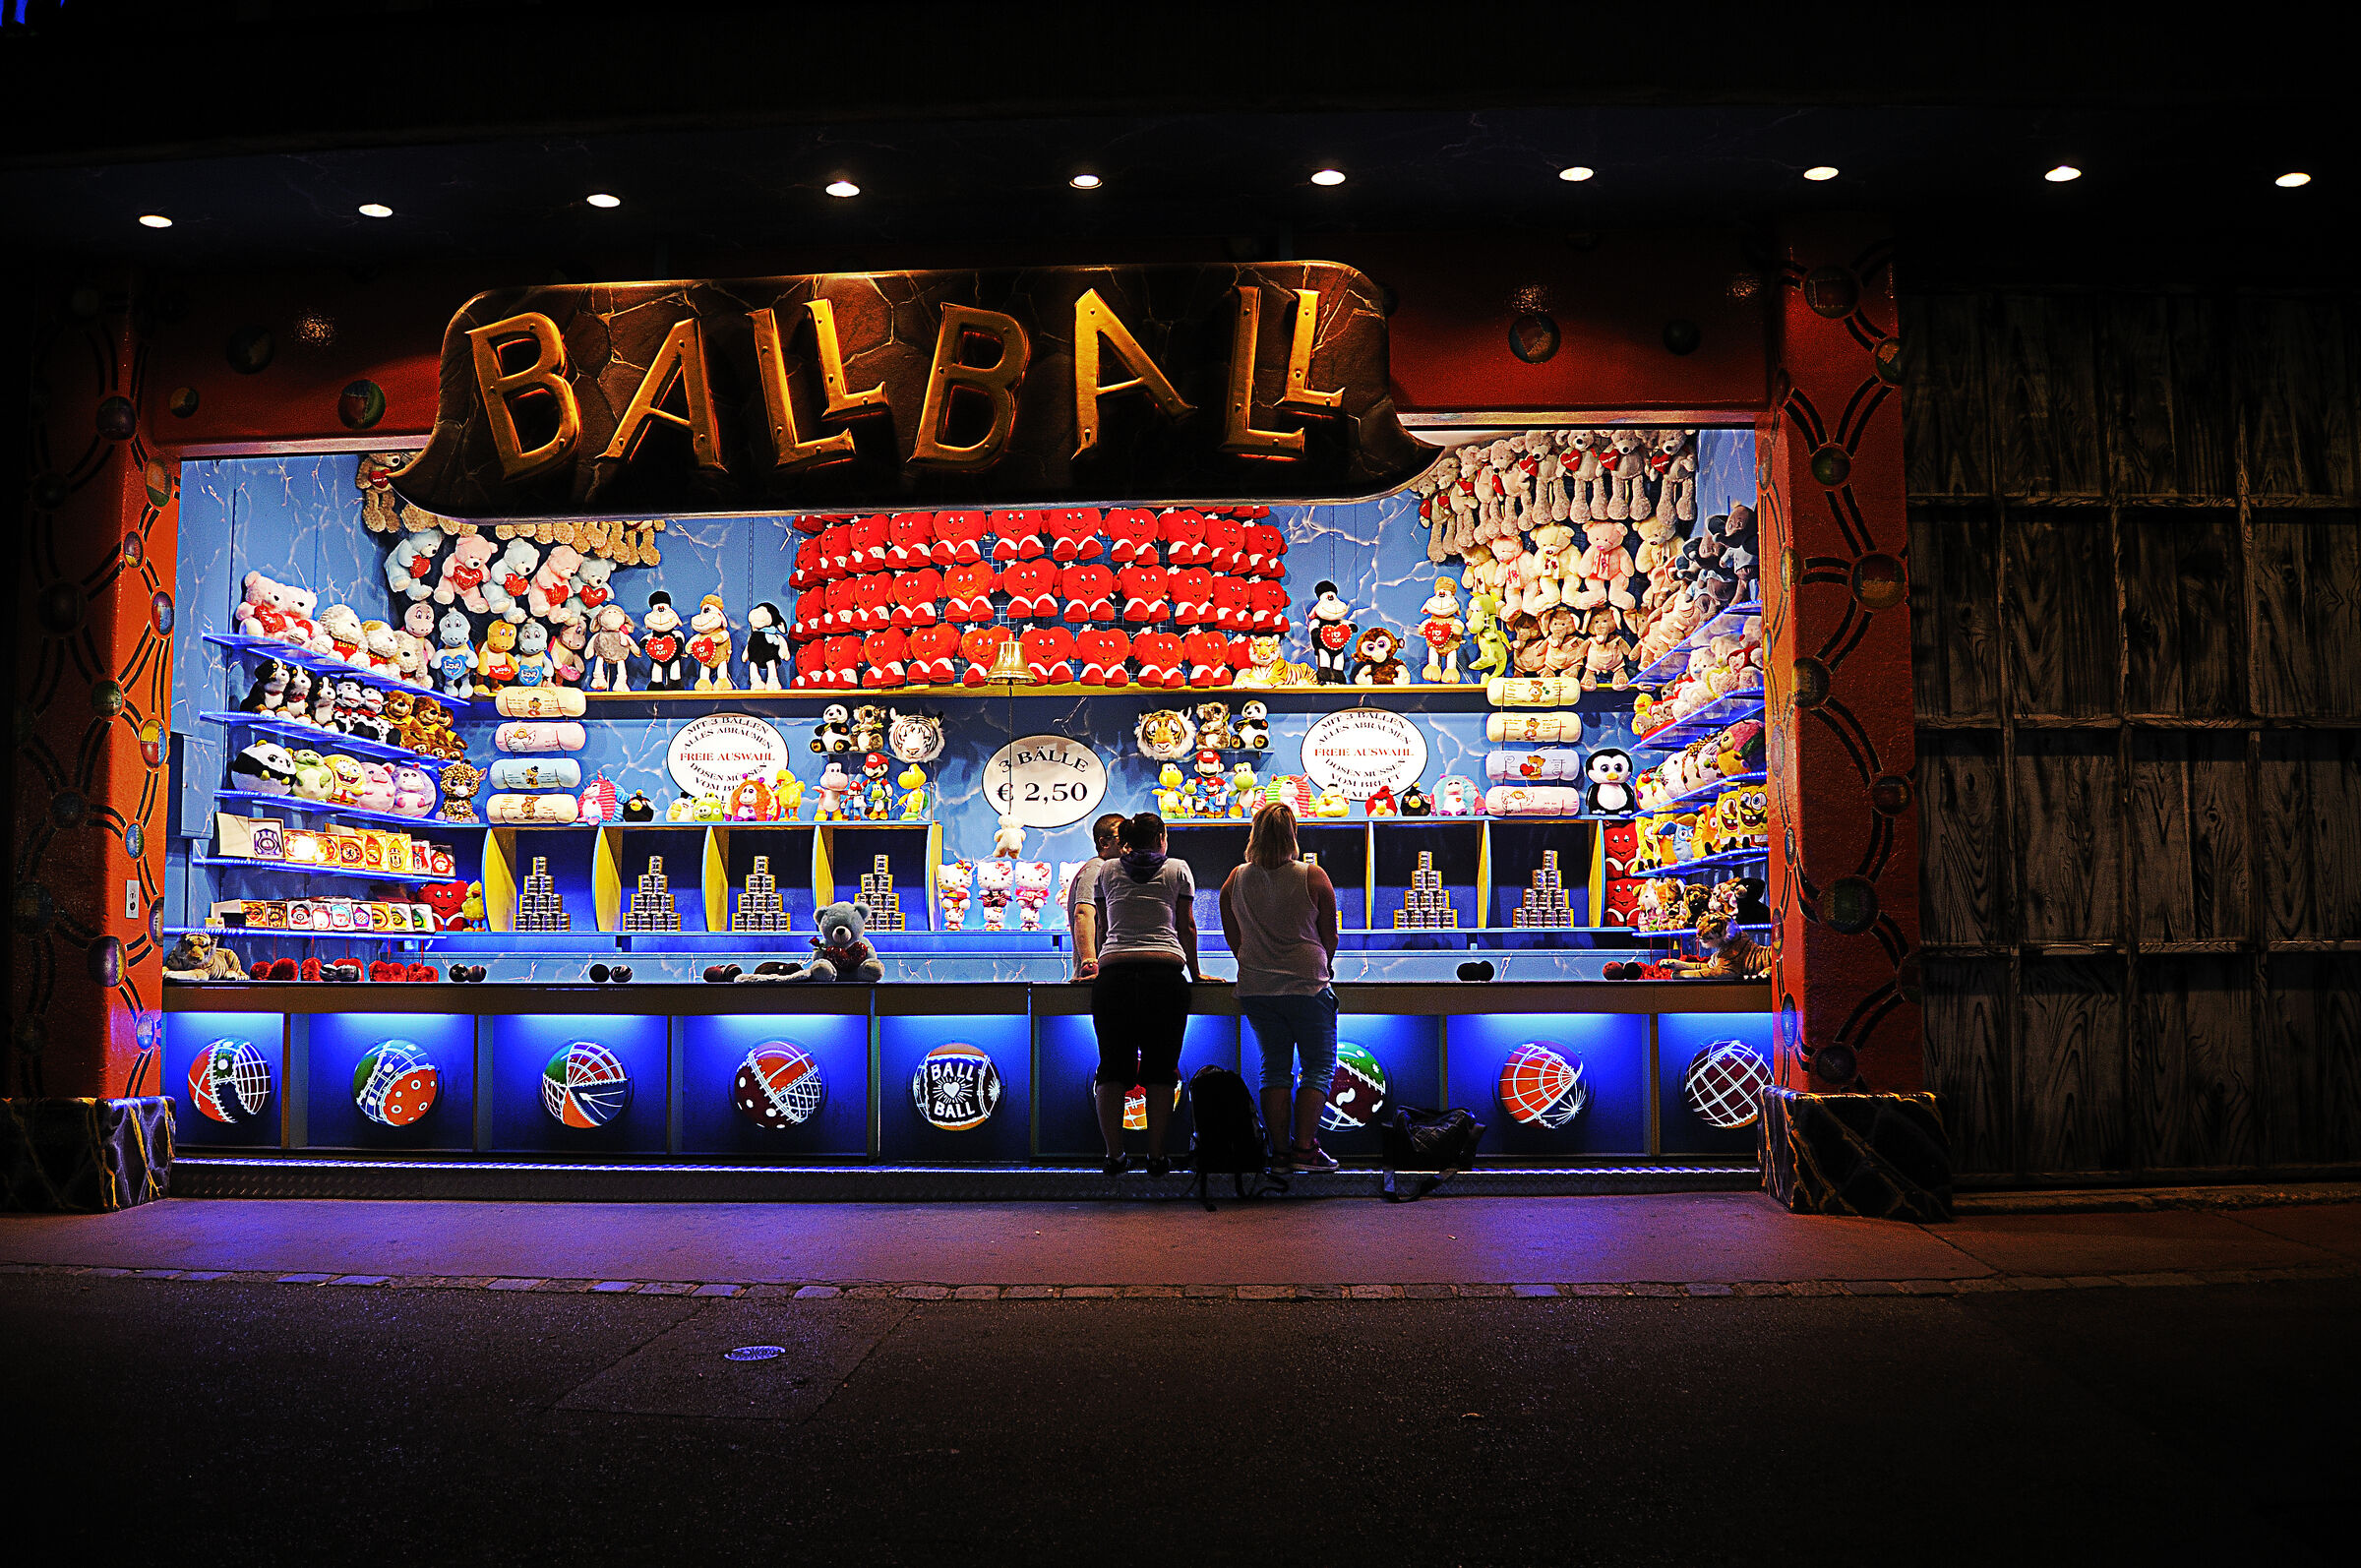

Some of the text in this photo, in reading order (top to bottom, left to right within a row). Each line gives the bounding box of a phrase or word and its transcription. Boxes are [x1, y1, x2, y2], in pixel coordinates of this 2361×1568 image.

[687, 720, 707, 735] MIT
[1321, 716, 1341, 729] MIT
[684, 729, 714, 750] ALLES
[1319, 725, 1350, 745] ALLES
[680, 753, 776, 761] FREIE AUSWAHL
[999, 747, 1089, 773] 3 BÄLLE
[690, 762, 724, 781] DOSEN
[1325, 758, 1361, 776] DOSEN
[695, 776, 720, 791] VOM
[1331, 773, 1357, 787] VOM
[997, 782, 1088, 805] € 2,50
[931, 1061, 974, 1081] BALL
[934, 1101, 976, 1118] BALL
